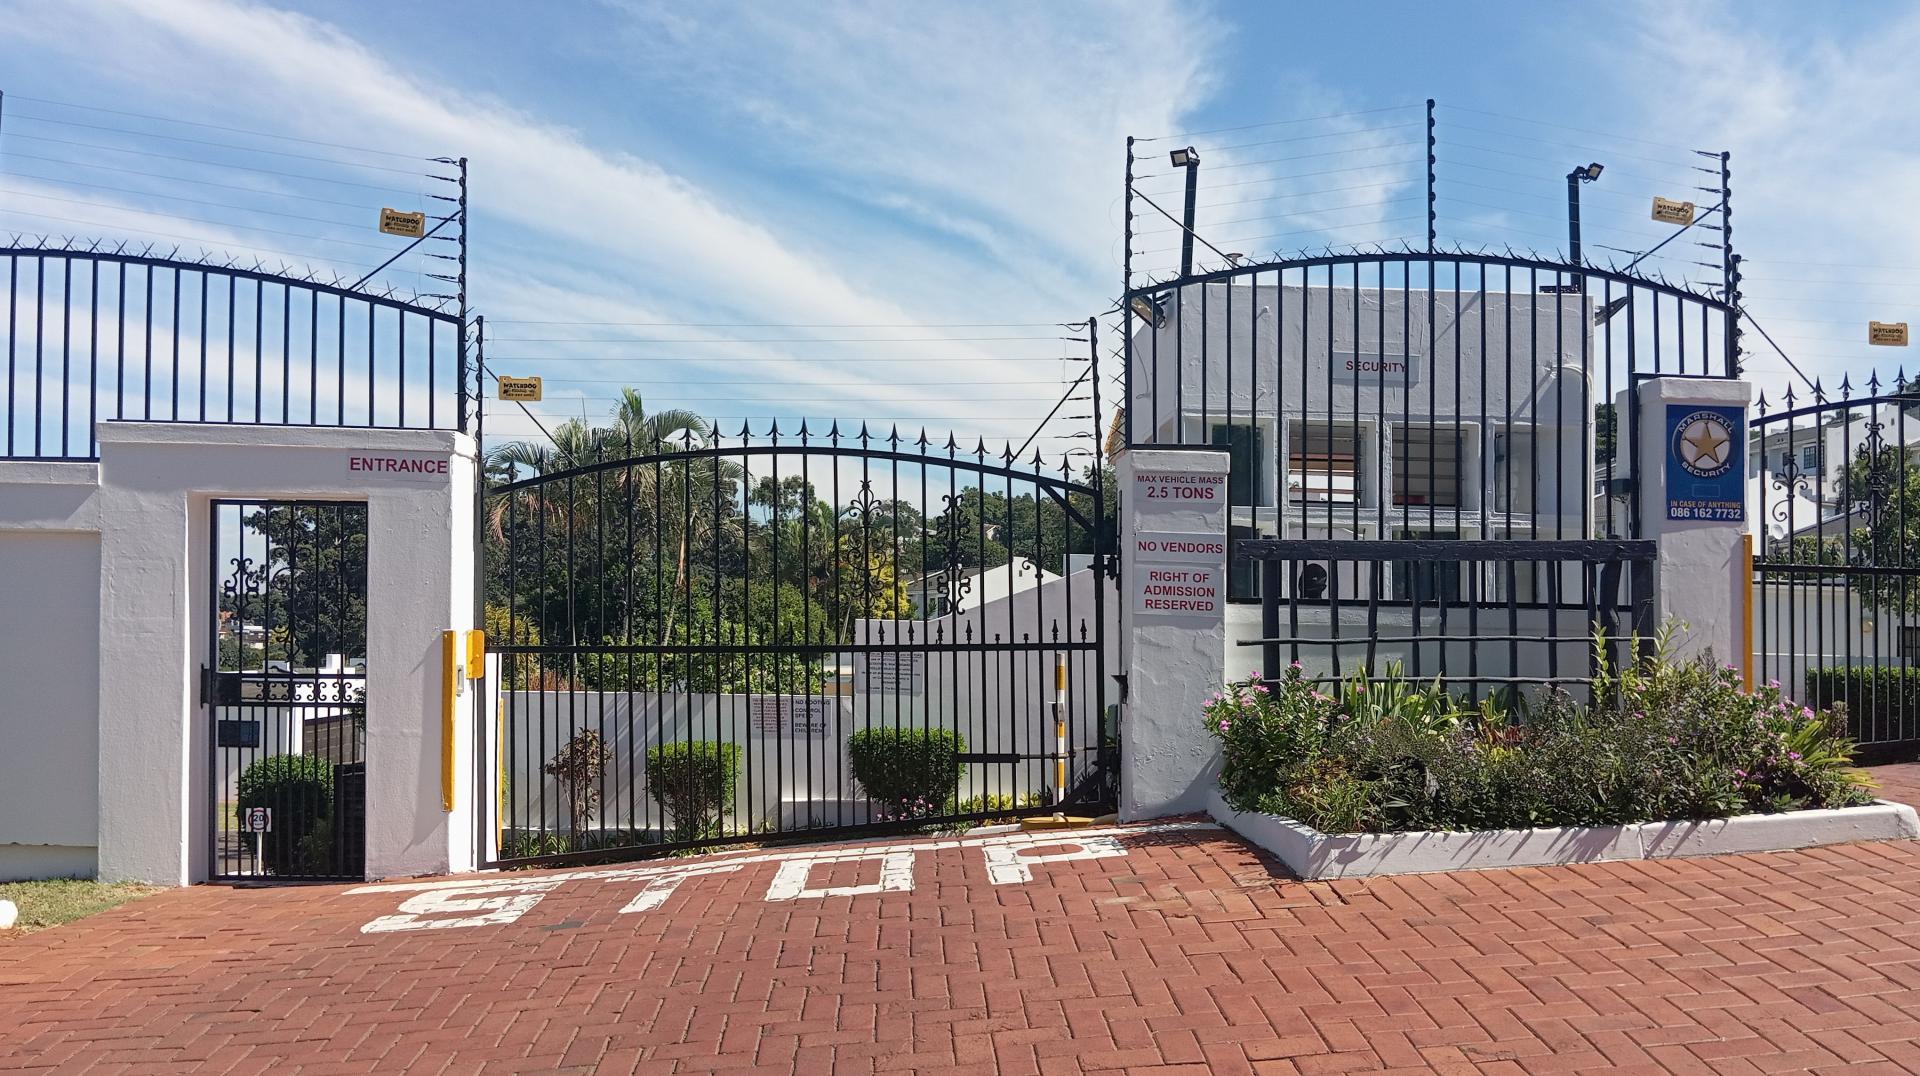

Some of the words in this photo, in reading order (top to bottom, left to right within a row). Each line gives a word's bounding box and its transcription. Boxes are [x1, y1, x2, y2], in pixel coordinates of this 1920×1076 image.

[1346, 360, 1407, 373] SECURITY
[1678, 413, 1733, 434] MARSHALL
[350, 457, 448, 474] ENTRANCE
[1681, 460, 1731, 477] SECURITY
[1137, 475, 1157, 483] MAX
[1159, 475, 1196, 484] VEHICLE
[1198, 476, 1224, 485] MASS
[1147, 486, 1168, 498] 2.5
[1173, 487, 1214, 500] TONS
[1680, 500, 1696, 508] CASE
[1708, 501, 1742, 509] ANYTHING
[1671, 507, 1690, 518] 086
[1693, 508, 1712, 518] 162
[1714, 509, 1741, 519] 7732
[1138, 541, 1157, 552] NO
[1160, 542, 1223, 554] VENDORS
[1150, 571, 1189, 582] RIGHT
[1192, 573, 1210, 583] OF
[1144, 585, 1215, 598] ADMISSION
[1145, 599, 1214, 611] RESERVED
[360, 836, 1129, 934] STOP
